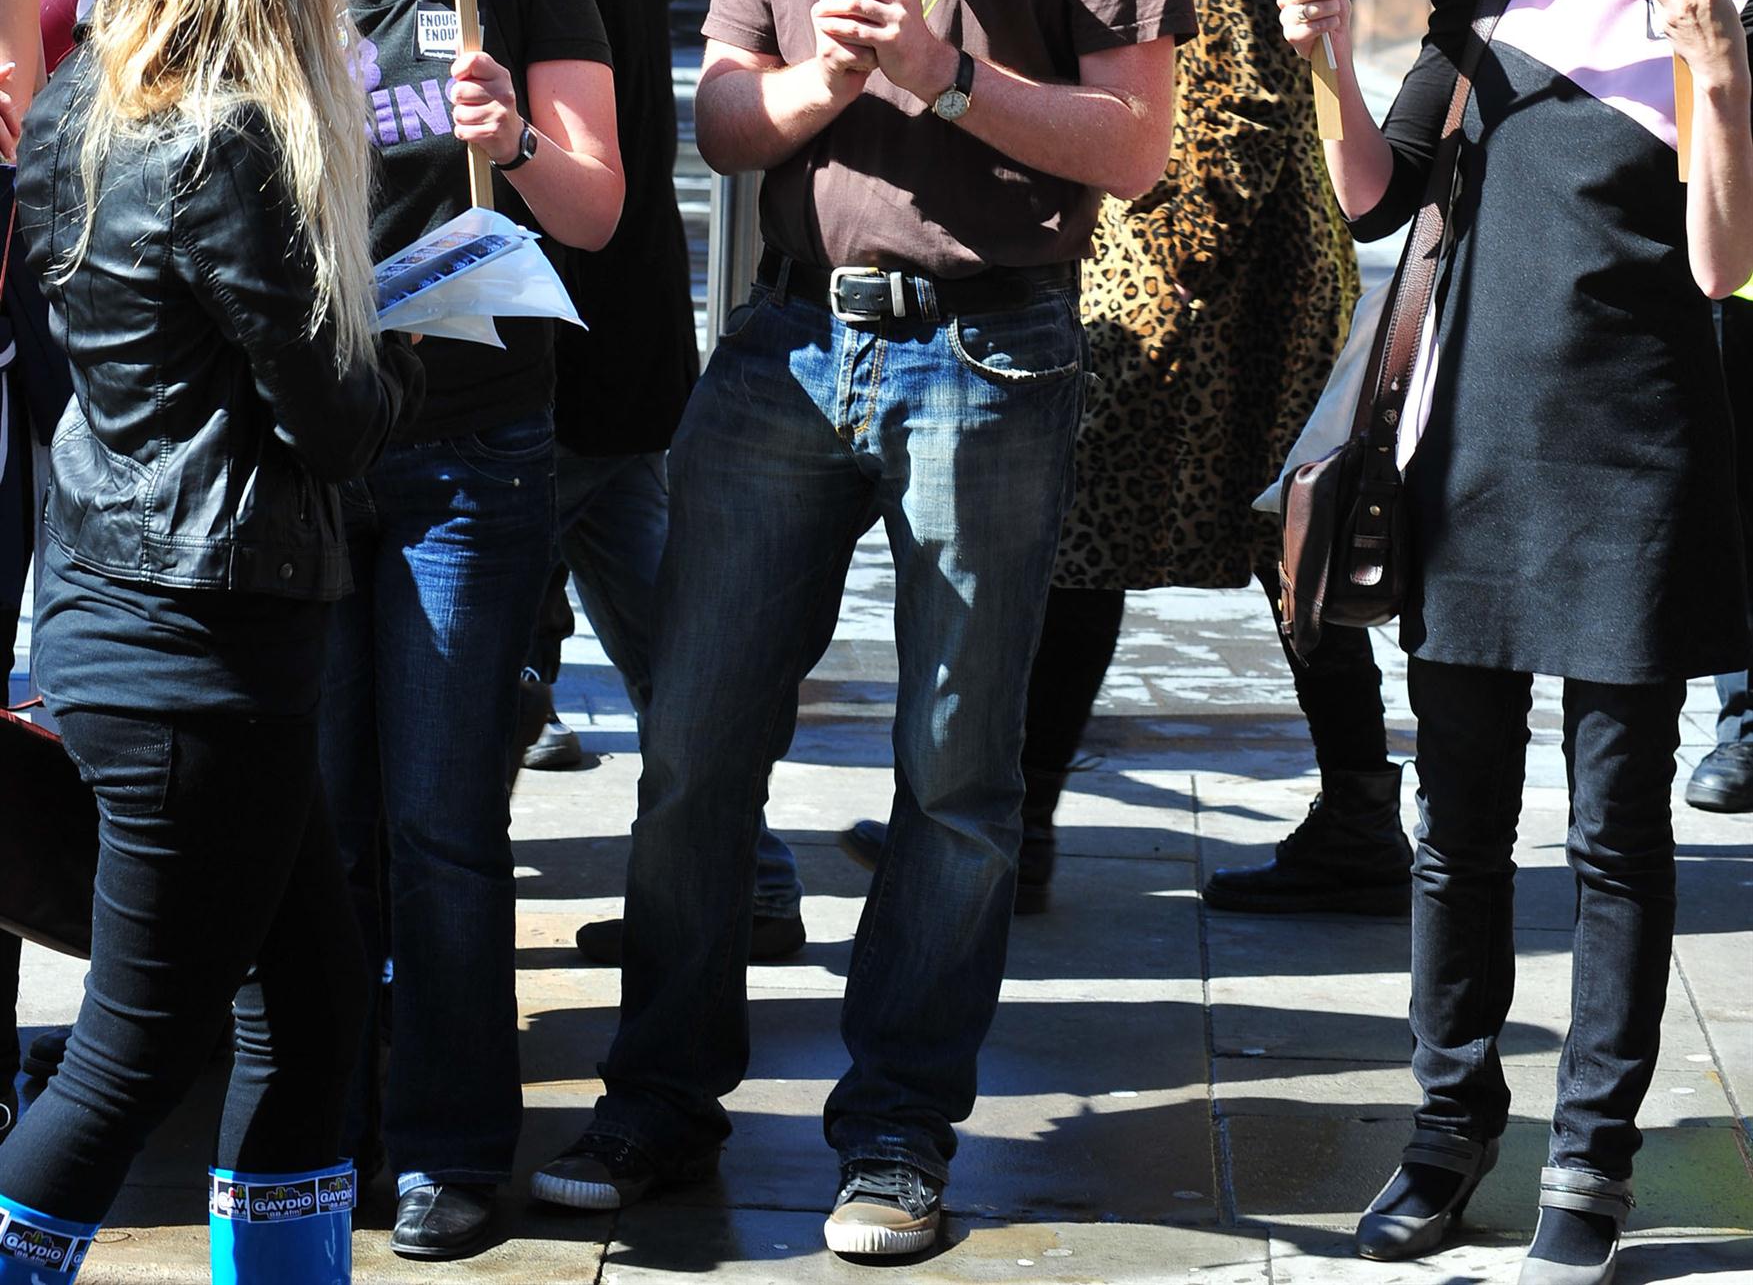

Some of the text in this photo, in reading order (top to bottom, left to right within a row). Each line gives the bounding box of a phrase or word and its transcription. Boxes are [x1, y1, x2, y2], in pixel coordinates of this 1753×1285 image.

[420, 13, 457, 27] ENOUG
[254, 1195, 312, 1212] GAYDIO
[6, 1235, 62, 1260] GAYDIO
